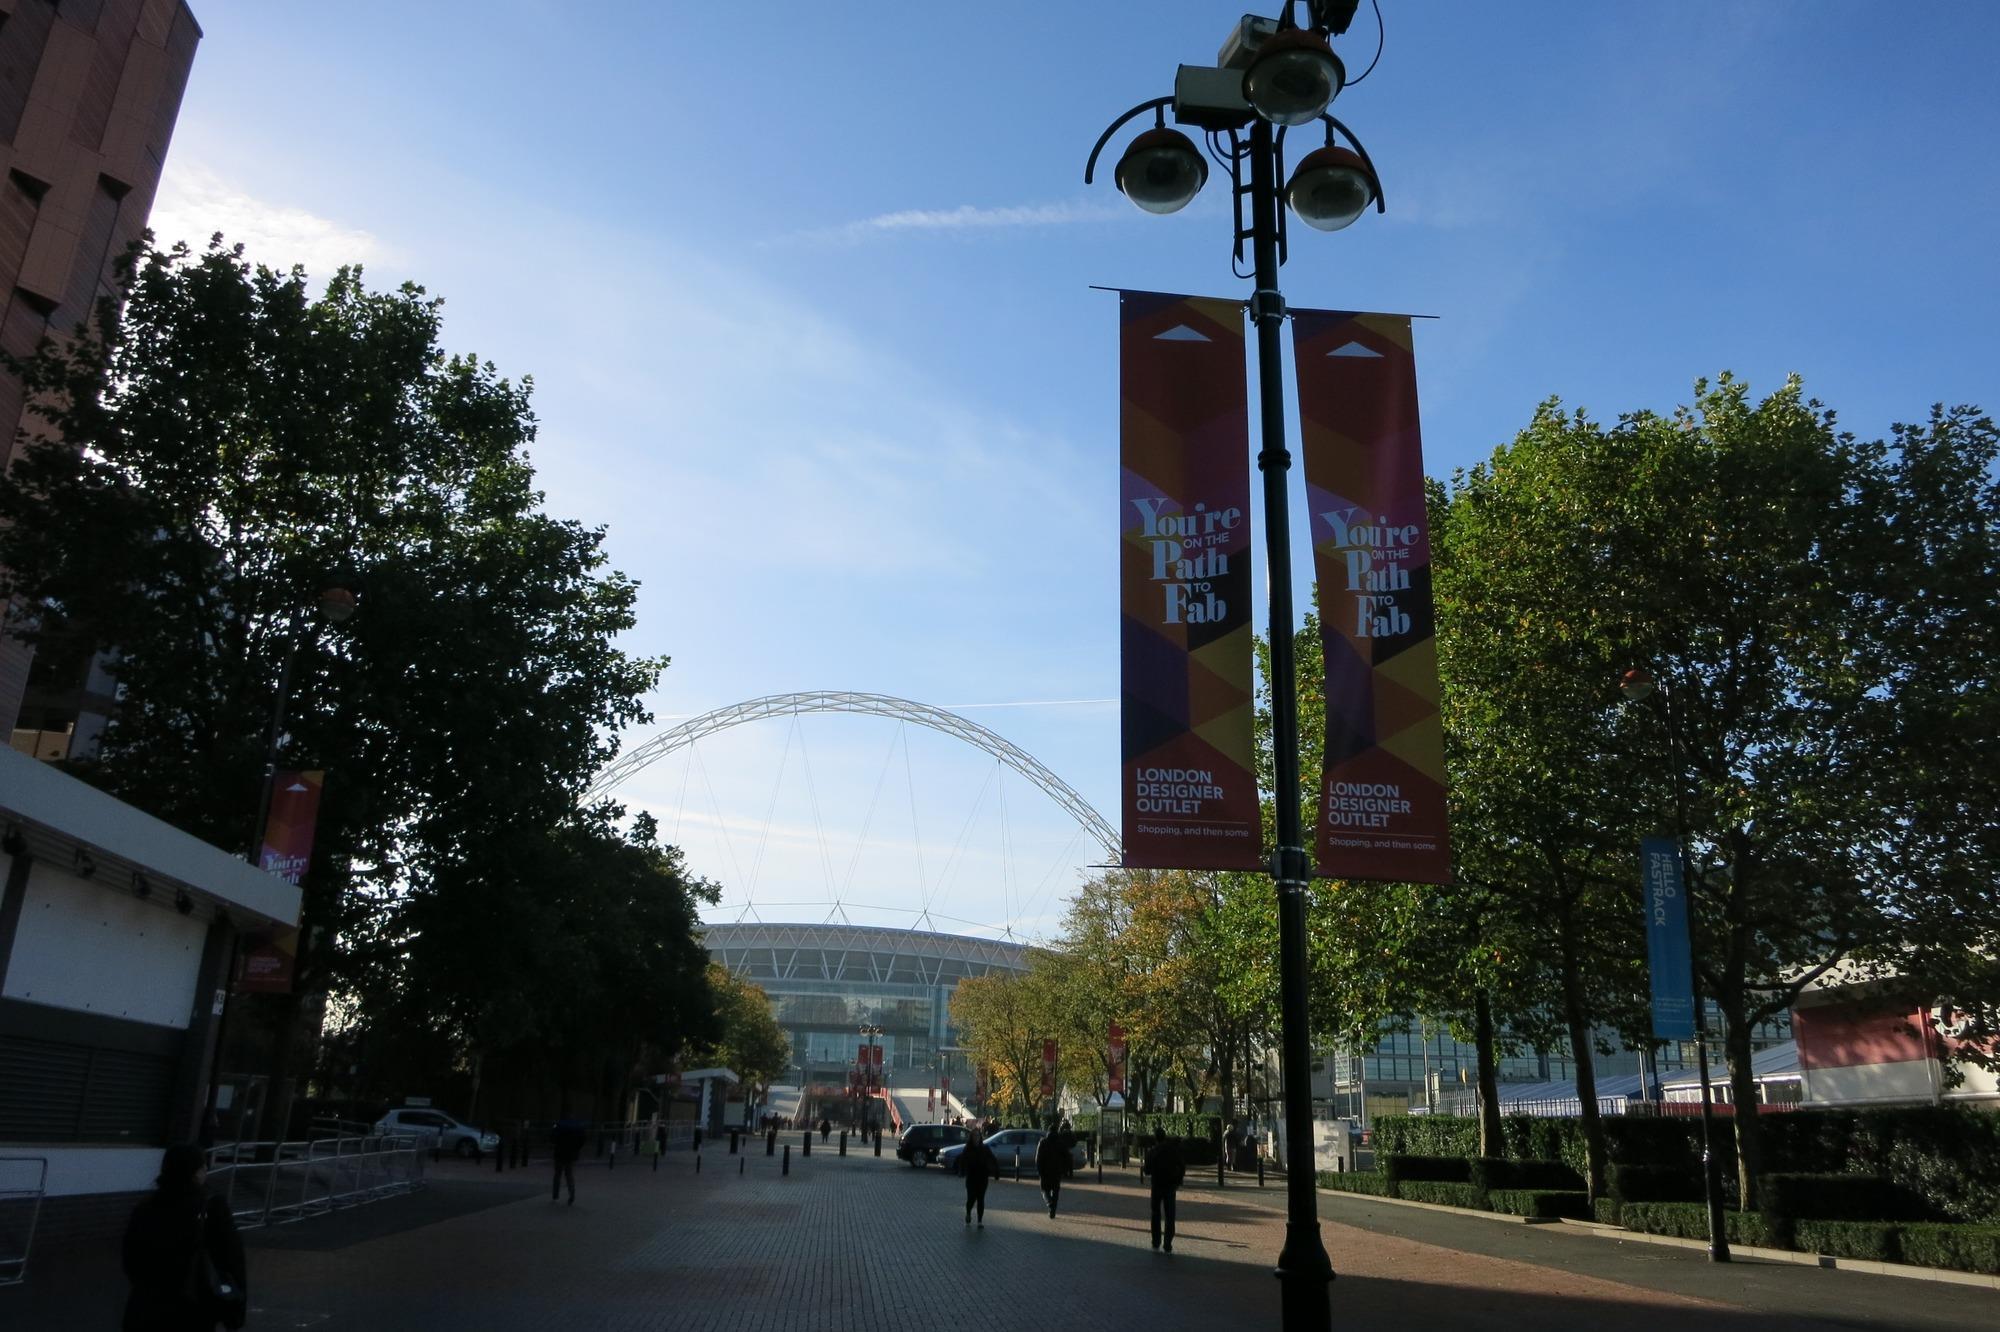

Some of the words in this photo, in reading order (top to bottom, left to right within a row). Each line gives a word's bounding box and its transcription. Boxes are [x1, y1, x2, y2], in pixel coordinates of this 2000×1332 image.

[1130, 497, 1241, 537] You're
[1320, 507, 1420, 548] You're
[1183, 538, 1202, 549] ON
[1205, 532, 1230, 546] THE
[1149, 539, 1230, 580] Path
[1371, 549, 1385, 560] ON
[1387, 548, 1410, 560] THE
[1342, 549, 1412, 592] Path
[1194, 581, 1212, 593] TO
[1162, 583, 1227, 624] Fab
[1377, 595, 1394, 606] TO
[1355, 594, 1411, 638] Fab
[1136, 767, 1213, 784] LONDON
[1136, 783, 1225, 800] DESIGNER
[1329, 780, 1400, 798] LONDON
[1136, 798, 1202, 815] OUTLET
[1329, 796, 1412, 814] DESIGNER
[1328, 811, 1390, 828] OUTLET
[1136, 824, 1182, 836] Shopping,
[1184, 826, 1202, 836] and
[1203, 827, 1223, 837] then
[1225, 829, 1249, 838] some
[1374, 840, 1391, 848] and
[1413, 842, 1437, 851] some
[1661, 853, 1677, 898] HELLO
[1651, 852, 1667, 926] FASTRACK
